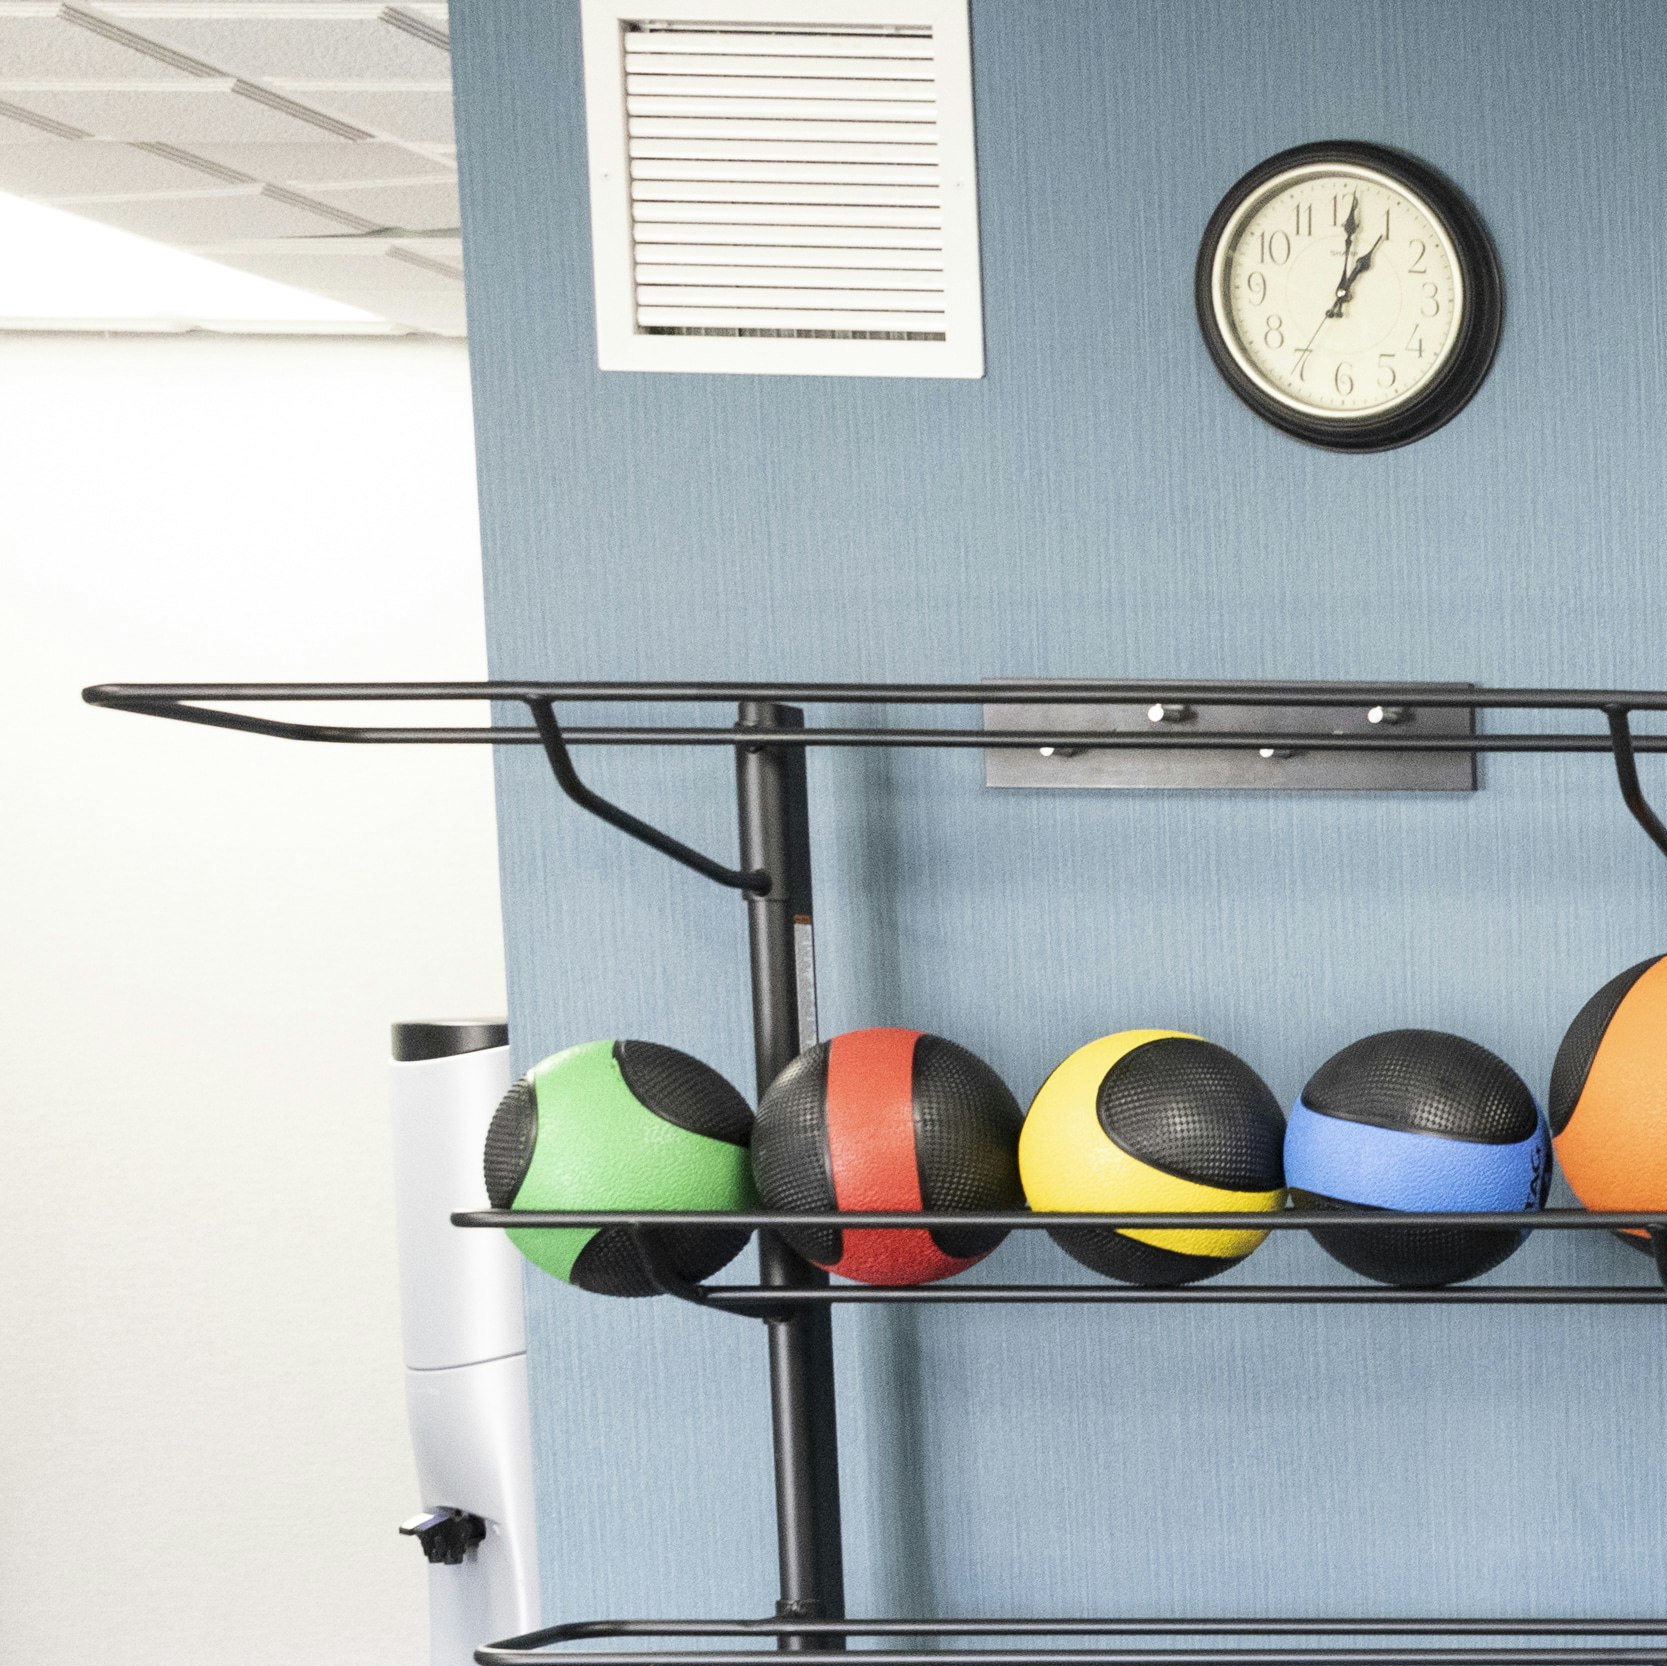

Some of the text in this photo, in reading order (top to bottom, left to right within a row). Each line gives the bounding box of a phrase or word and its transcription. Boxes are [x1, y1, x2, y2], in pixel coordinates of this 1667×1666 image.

[1294, 203, 1312, 236] 11
[1331, 191, 1359, 229] 12
[1258, 230, 1291, 266] 10
[1407, 239, 1427, 273] 2
[1247, 271, 1267, 306] 9
[1420, 282, 1439, 317] 3
[1264, 314, 1284, 349] 8
[1404, 323, 1424, 358] 4
[1294, 348, 1313, 382] 7
[1334, 362, 1354, 396] 6
[1377, 353, 1396, 388] 5
